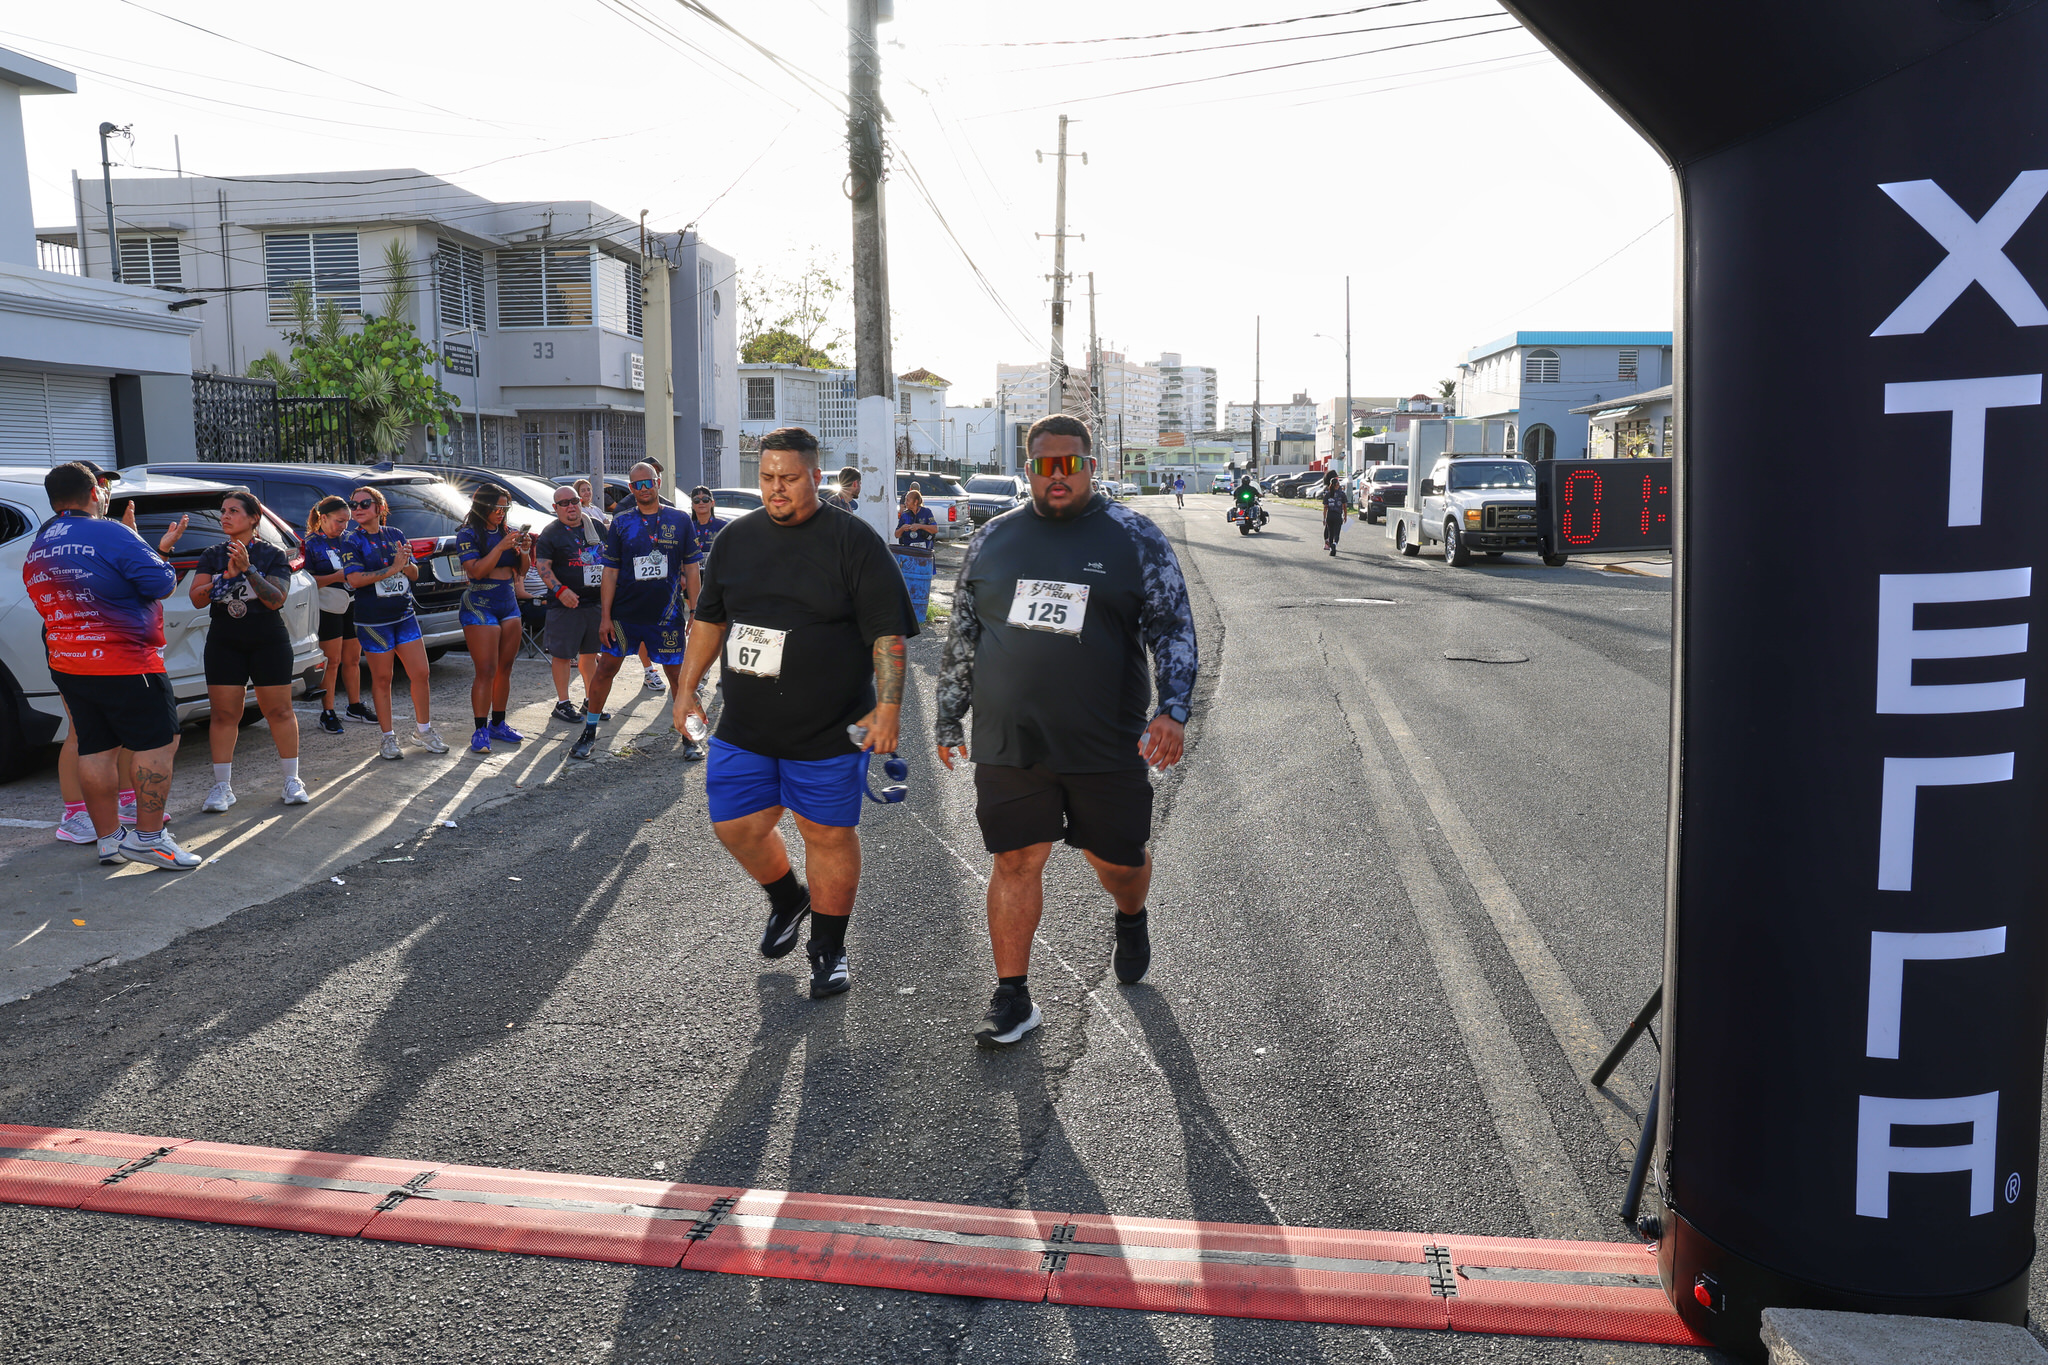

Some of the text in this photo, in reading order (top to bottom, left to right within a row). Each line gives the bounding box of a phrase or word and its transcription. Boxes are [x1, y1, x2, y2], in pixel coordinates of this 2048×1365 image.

[533, 342, 554, 359] 33
[460, 542, 471, 551] TF
[342, 552, 354, 563] TF
[641, 565, 662, 577] 225
[1041, 583, 1066, 592] FADE
[1051, 591, 1073, 600] RUN
[1028, 602, 1068, 625] 125
[745, 627, 765, 637] FADE
[753, 637, 770, 645] RUN
[739, 646, 761, 667] 67
